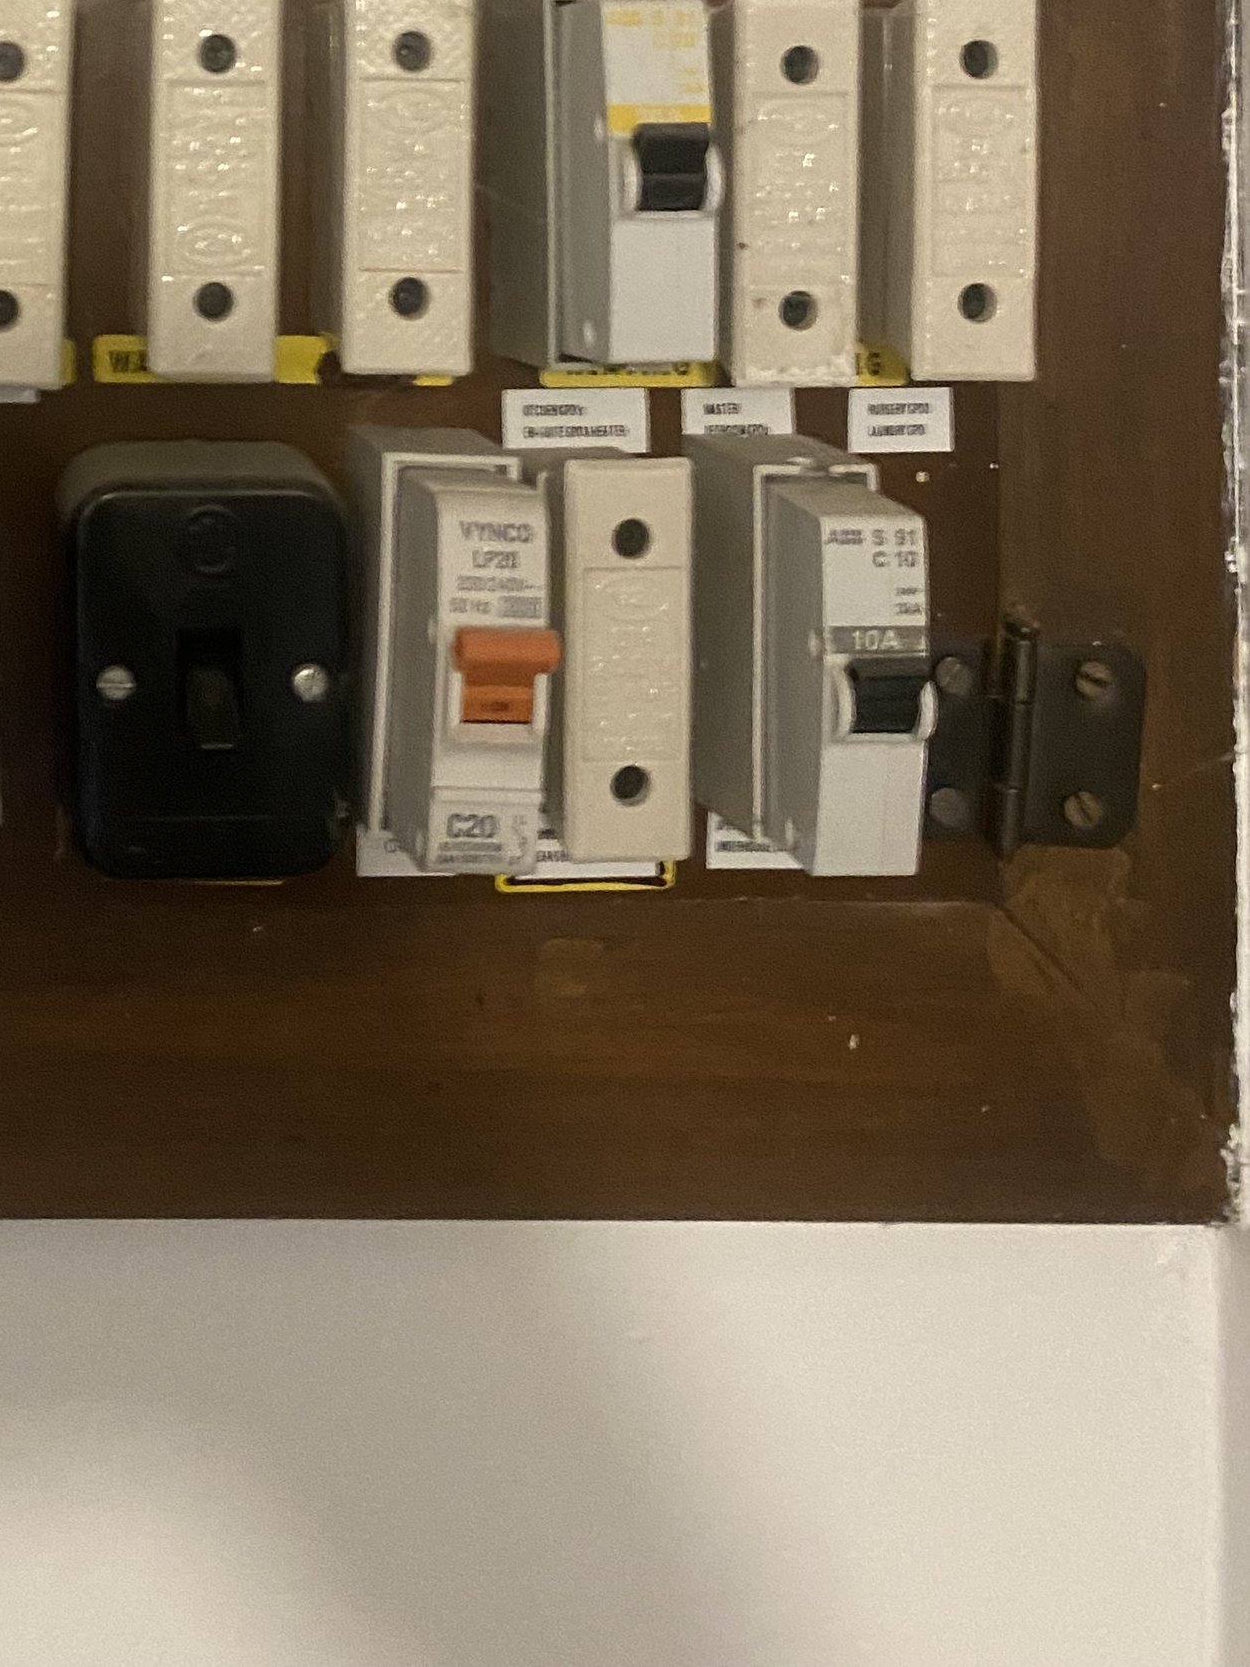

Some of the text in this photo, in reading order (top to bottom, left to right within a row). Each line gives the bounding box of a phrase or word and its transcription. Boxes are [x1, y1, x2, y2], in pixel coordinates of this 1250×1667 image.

[703, 402, 742, 415] MASTER
[872, 550, 890, 567] C
[852, 629, 898, 650] 10A
[447, 813, 499, 838] C20
